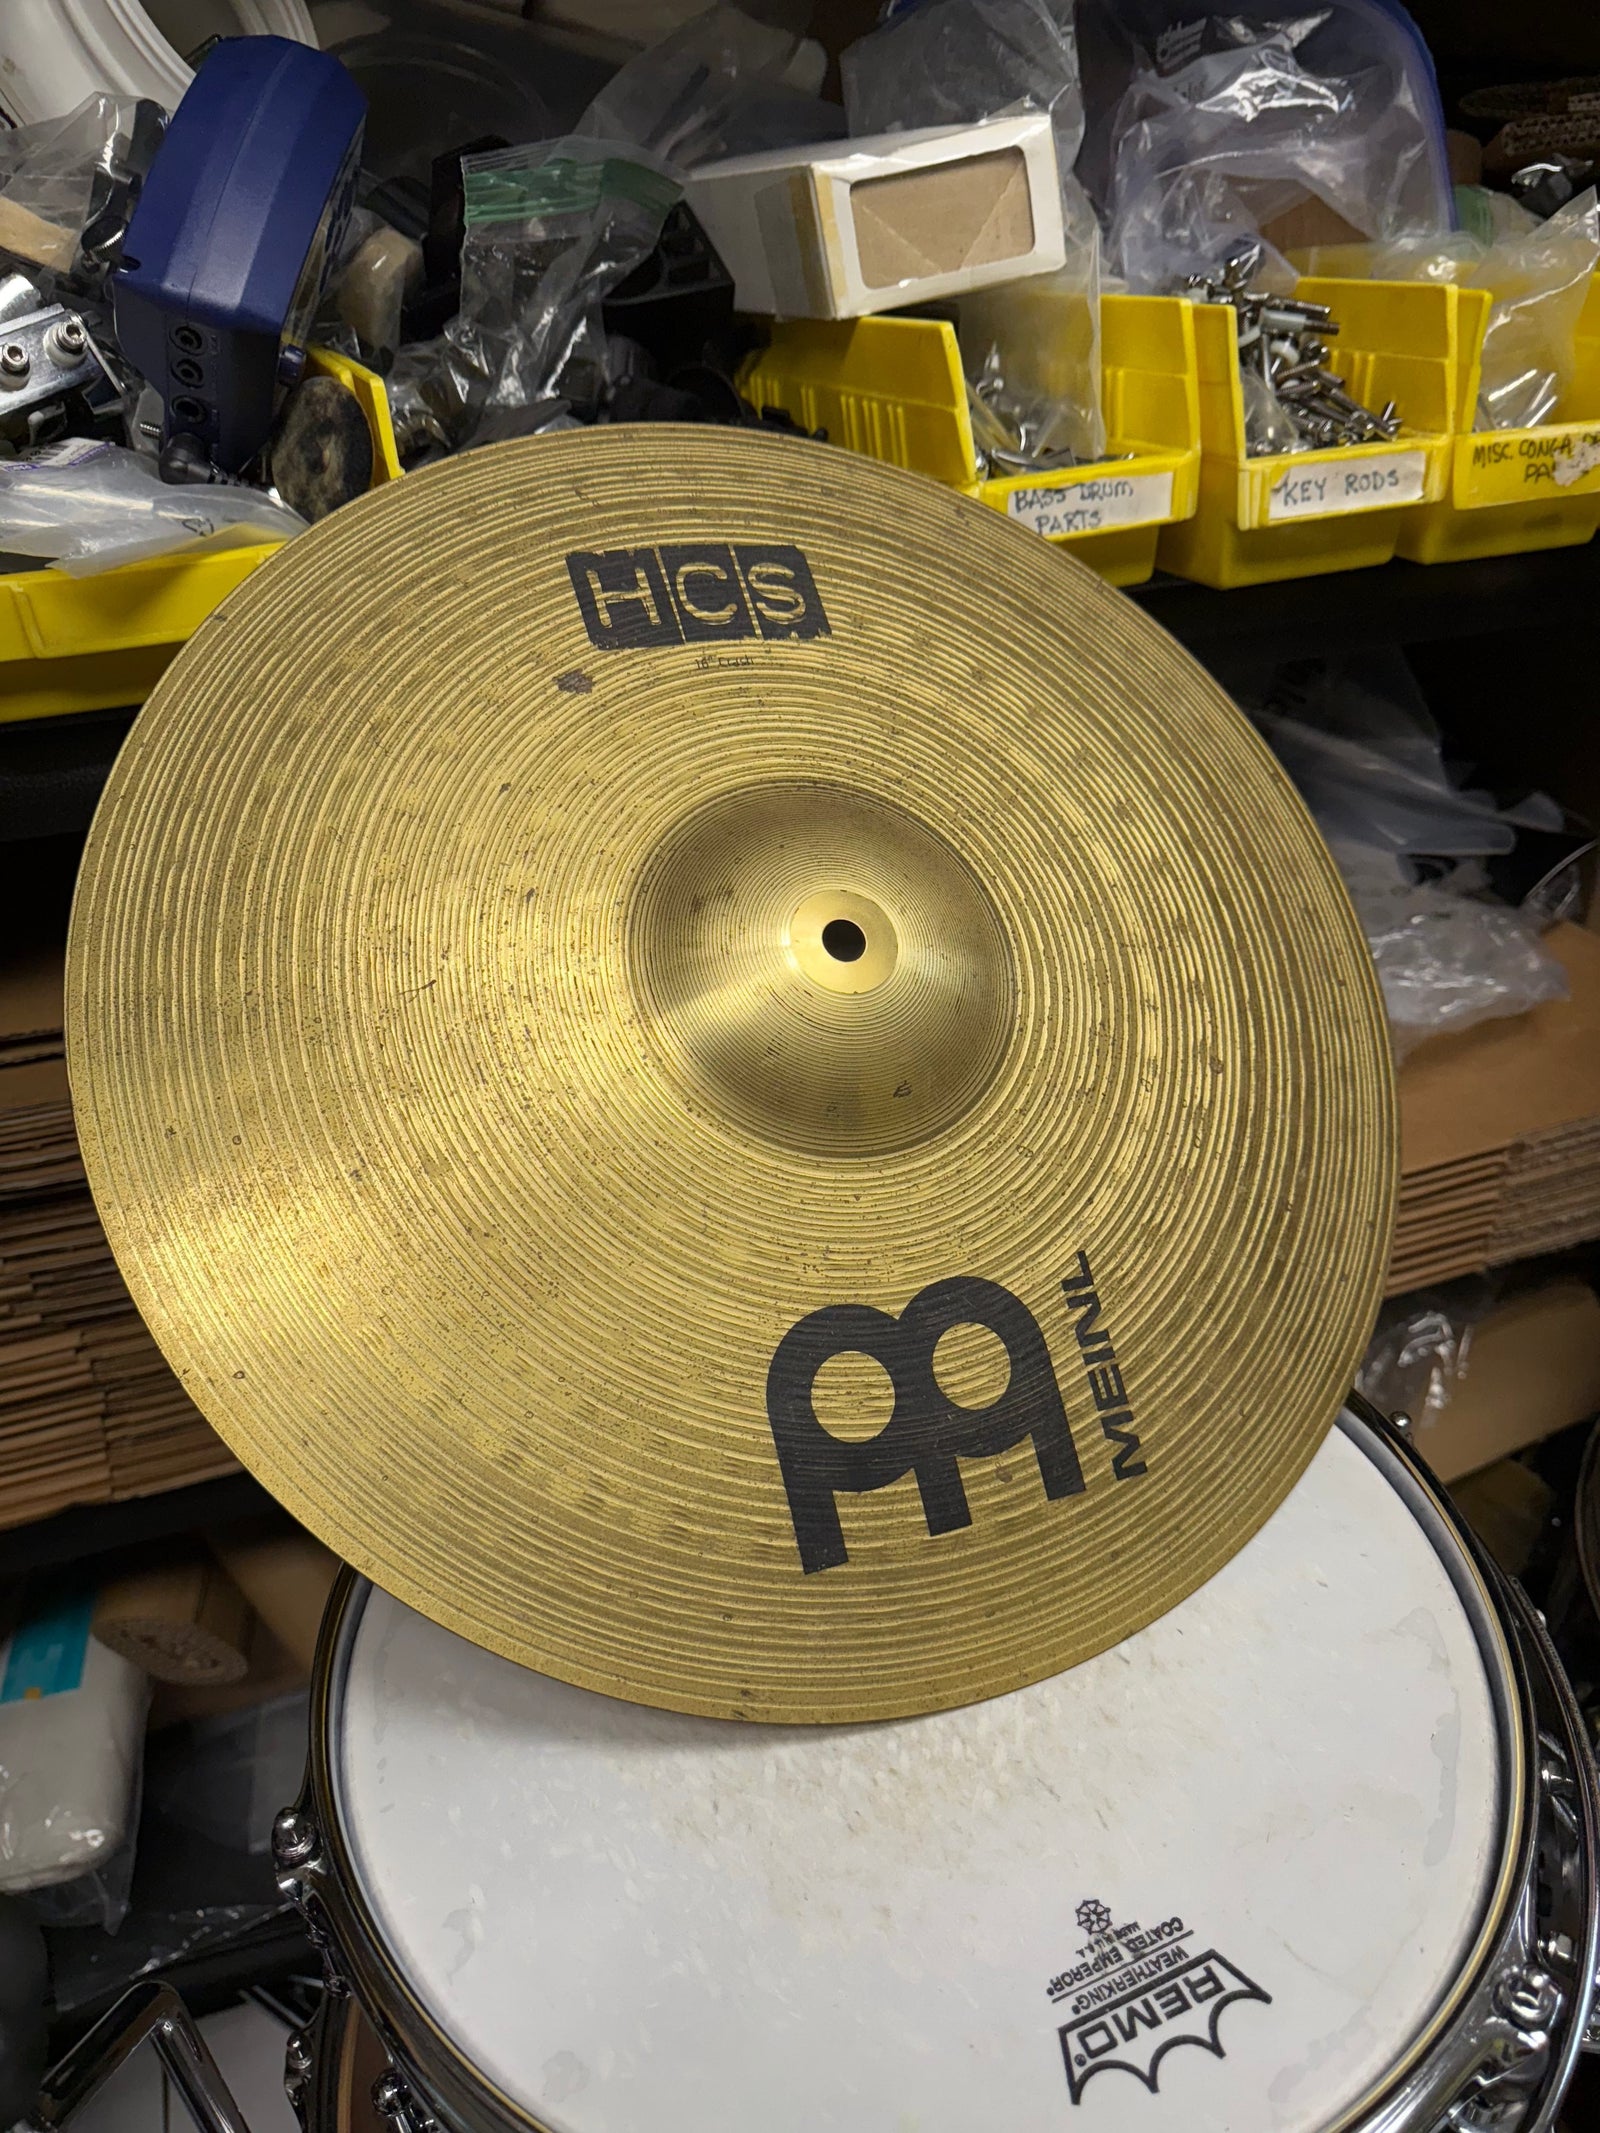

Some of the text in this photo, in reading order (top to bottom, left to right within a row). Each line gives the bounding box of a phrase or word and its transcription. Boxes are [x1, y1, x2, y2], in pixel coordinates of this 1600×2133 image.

[1014, 487, 1067, 513] BASS
[1282, 469, 1400, 506] KEY RODS
[1035, 509, 1102, 535] PARTS
[584, 561, 808, 630] HCS
[1060, 1249, 1148, 1482] MEINL
[1123, 1915, 1185, 1953] COATED
